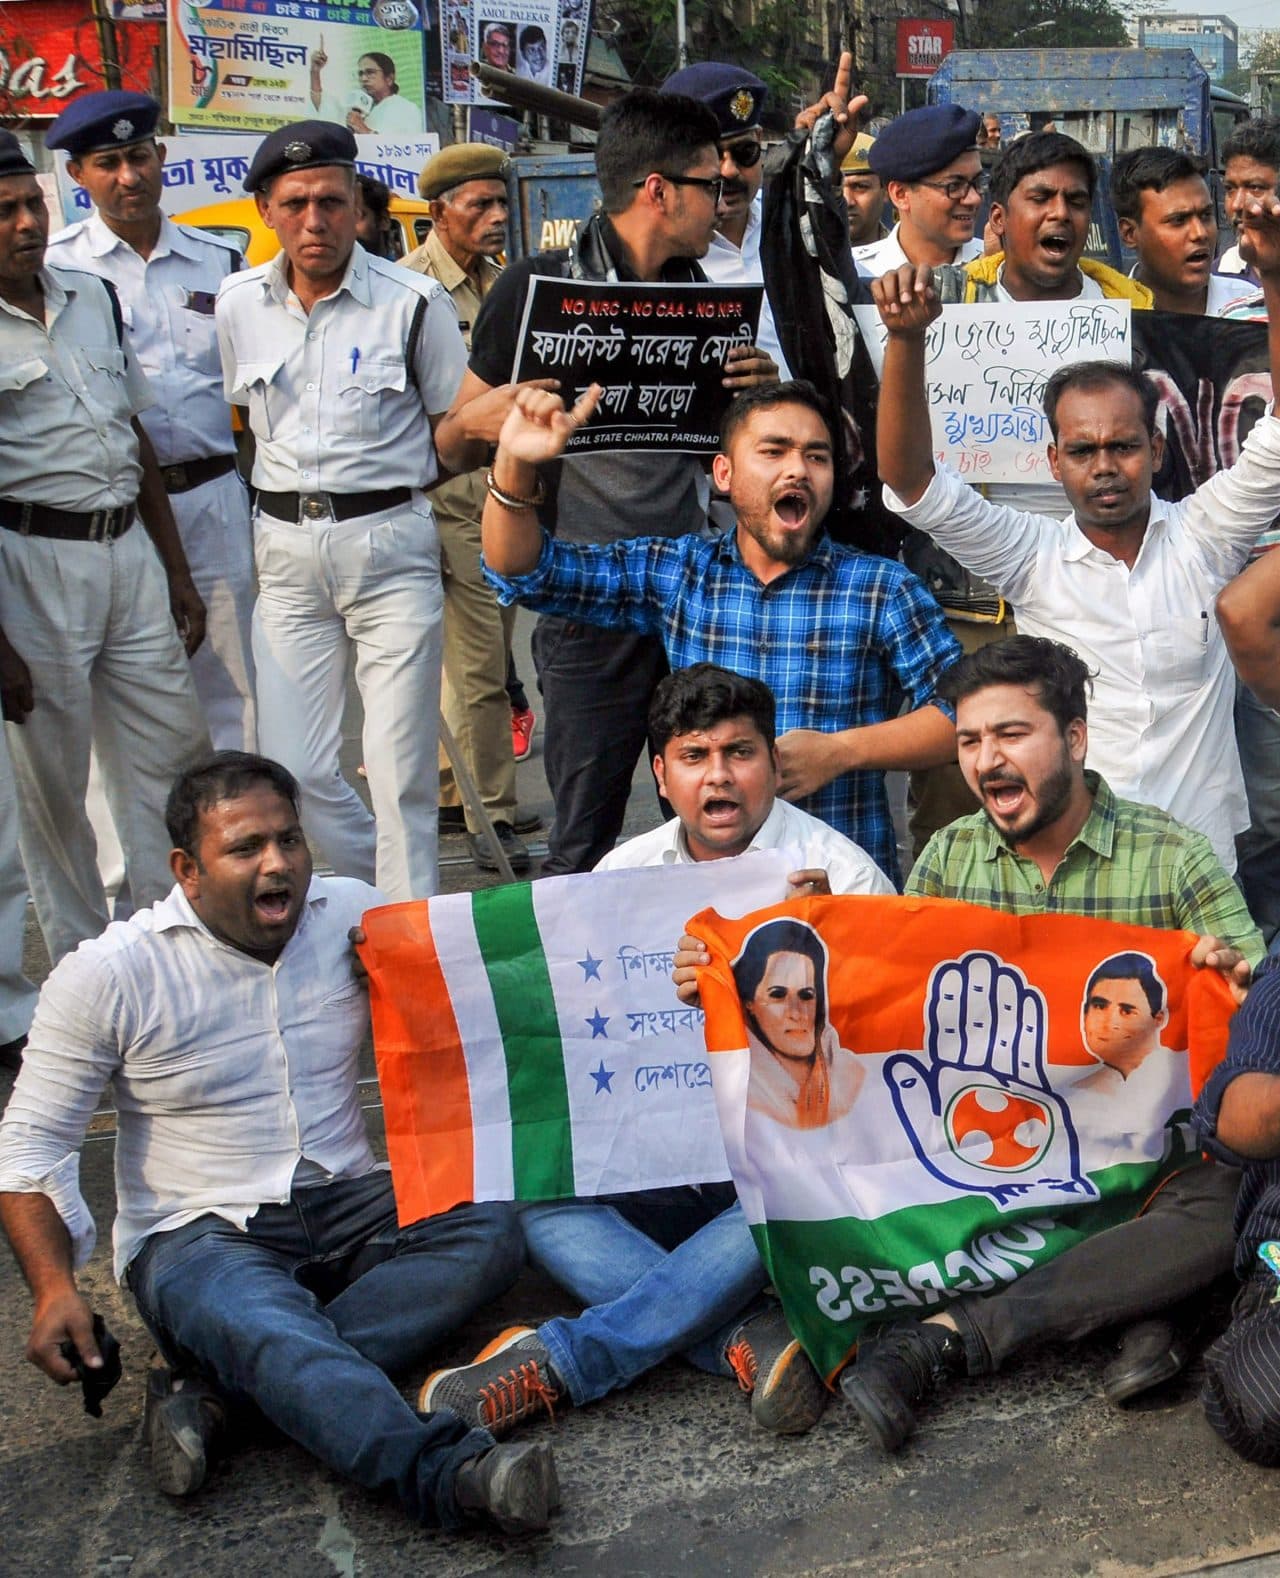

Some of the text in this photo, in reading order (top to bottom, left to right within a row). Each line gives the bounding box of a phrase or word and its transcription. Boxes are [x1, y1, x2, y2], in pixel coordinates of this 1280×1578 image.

[481, 7, 551, 23] AMOL PALEKAR
[187, 33, 308, 69] মহামিছিল
[908, 34, 942, 54] STAR
[0, 51, 86, 98] as
[376, 143, 432, 158] ১৮৯৩ সন
[561, 297, 586, 316] NO
[588, 299, 620, 317] NRC
[631, 301, 653, 318] NO
[656, 302, 685, 318] CAA
[695, 302, 715, 318] NO
[717, 302, 743, 318] NPR
[531, 321, 626, 366] ফ্যাসিস্ট
[630, 334, 698, 370] নরেন্দ্র
[955, 320, 1015, 365] জুড়ে
[1025, 304, 1128, 359] মৃত্যুমিছিল
[637, 381, 697, 419] ছাড়ো
[594, 432, 622, 444] STATE
[624, 432, 669, 443] CHHATRA
[671, 432, 720, 445] PARISHAD
[616, 944, 676, 981] শিক্ষ
[634, 1060, 713, 1092] দেশপ্রে
